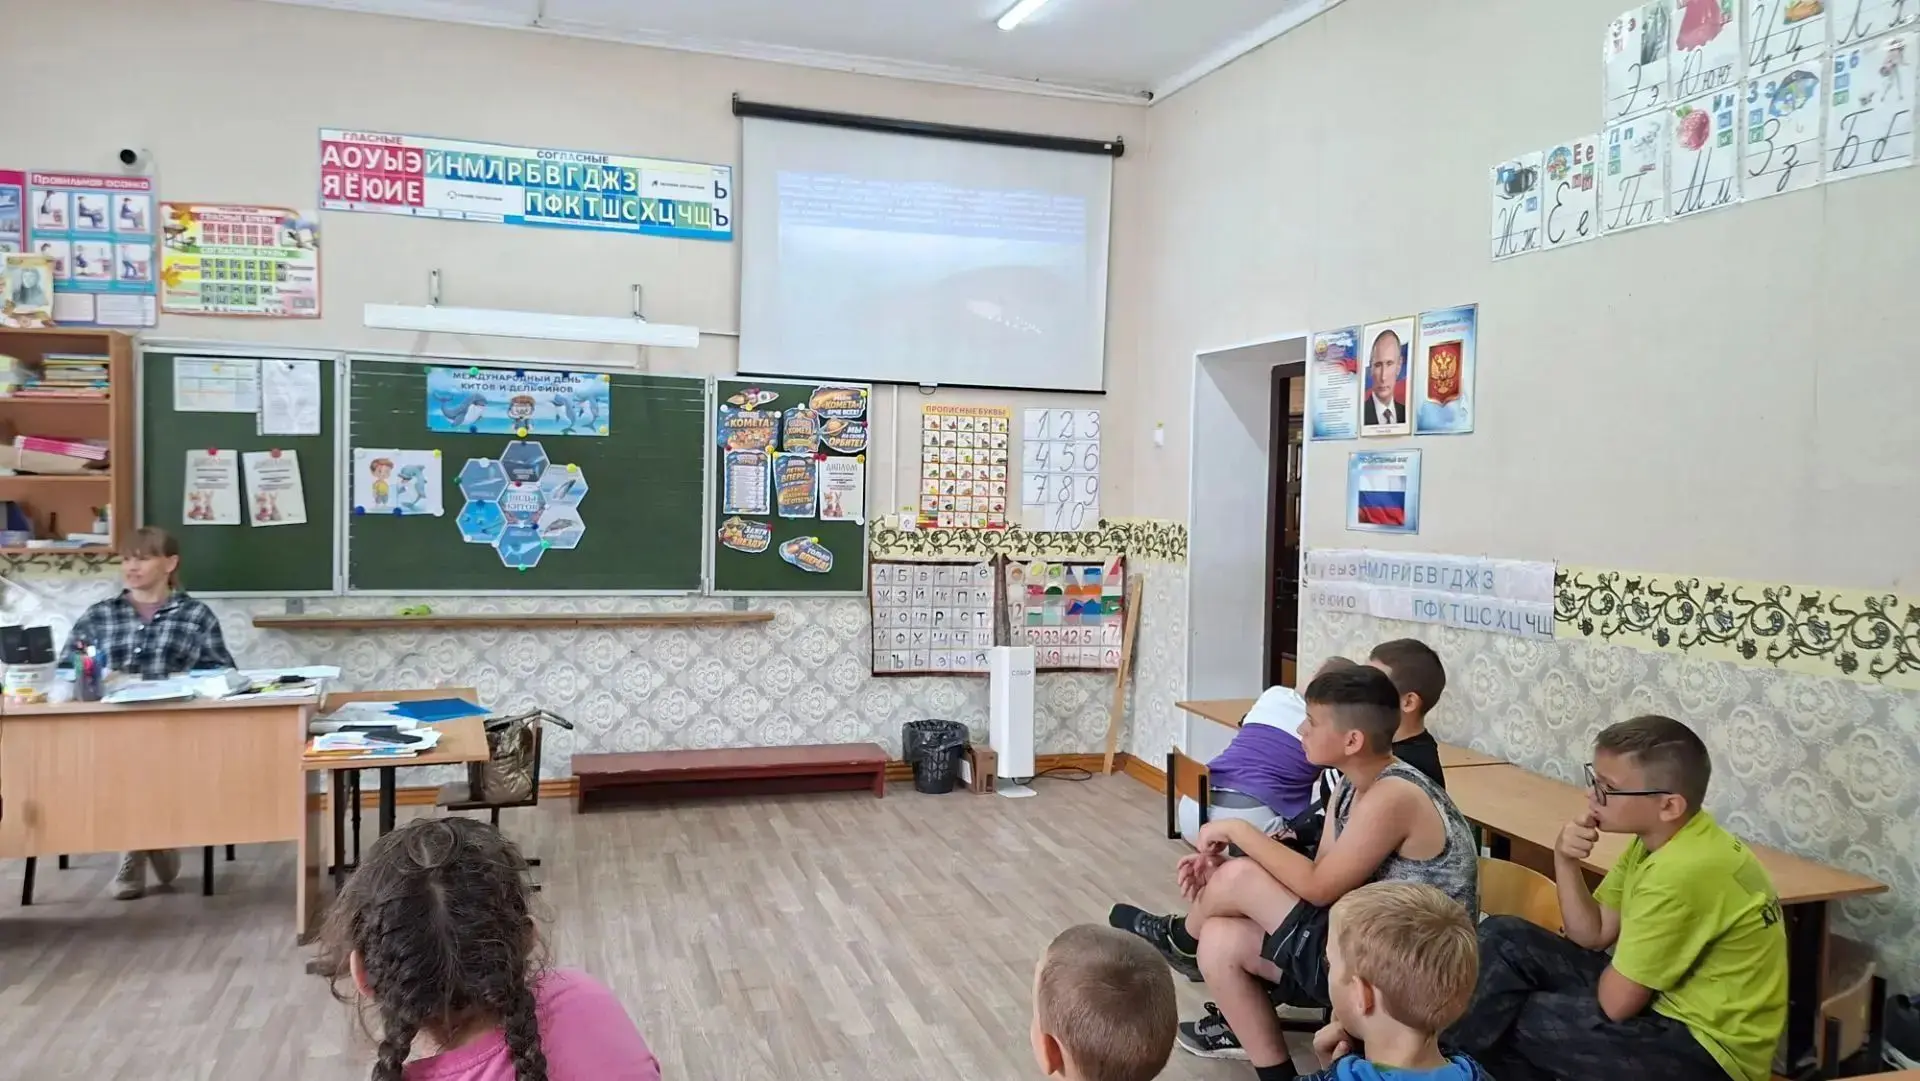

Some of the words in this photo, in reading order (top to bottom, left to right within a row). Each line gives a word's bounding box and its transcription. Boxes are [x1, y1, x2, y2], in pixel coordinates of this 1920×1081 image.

[342, 132, 404, 145] ГЛАСНЫЕ
[537, 150, 609, 164] СОГЛАСНЫЕ
[926, 406, 977, 415] ПРОПИСНЫЕ
[1059, 411, 1073, 438] 2
[1085, 411, 1100, 438] 3
